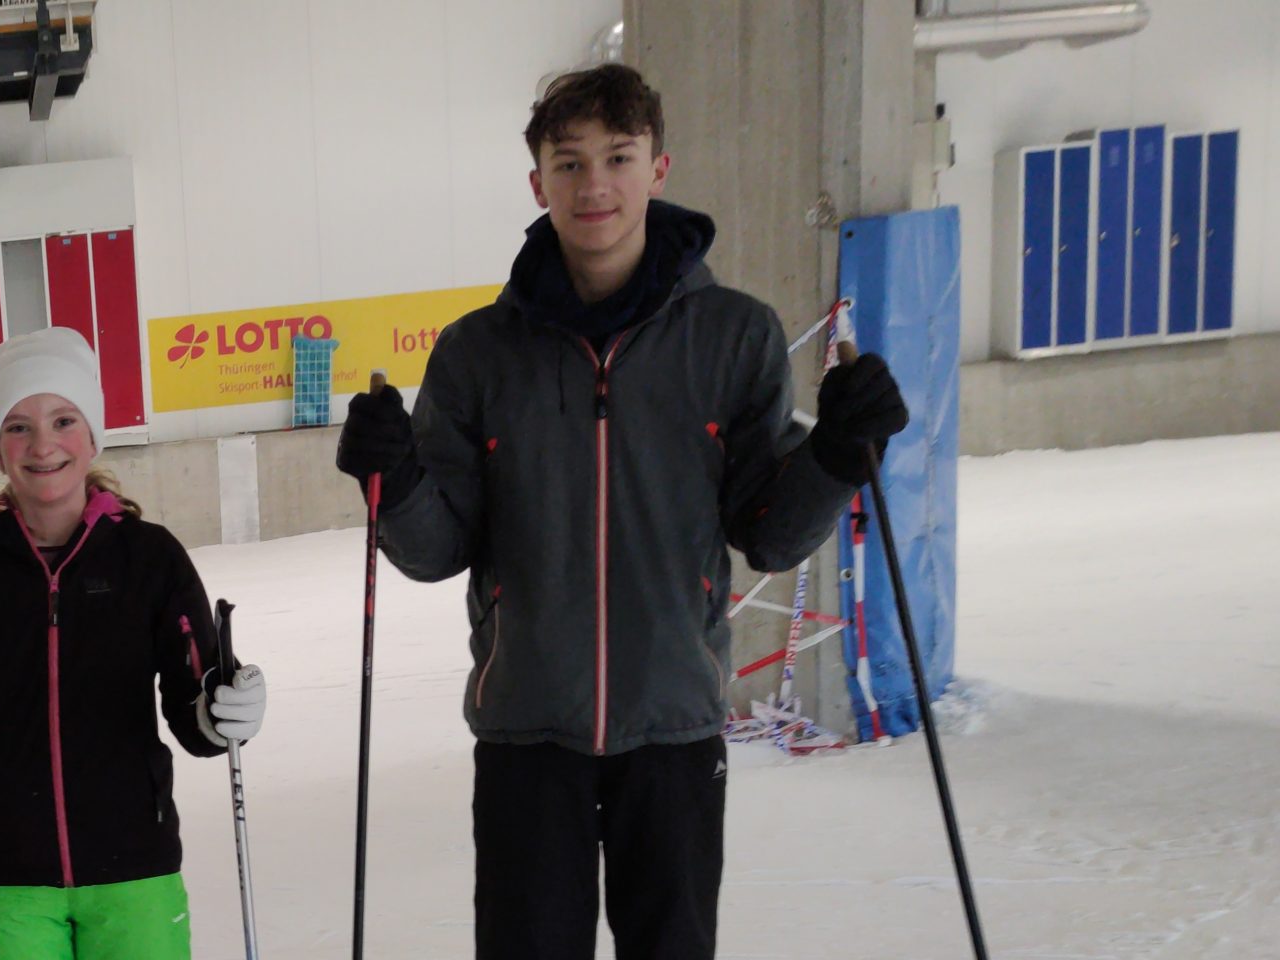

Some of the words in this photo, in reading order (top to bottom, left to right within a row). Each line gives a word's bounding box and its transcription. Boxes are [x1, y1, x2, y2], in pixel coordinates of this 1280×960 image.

[216, 315, 333, 355] LOTTO
[393, 327, 439, 353] lott
[218, 360, 275, 375] Thüringen
[231, 767, 246, 822] LEKI
